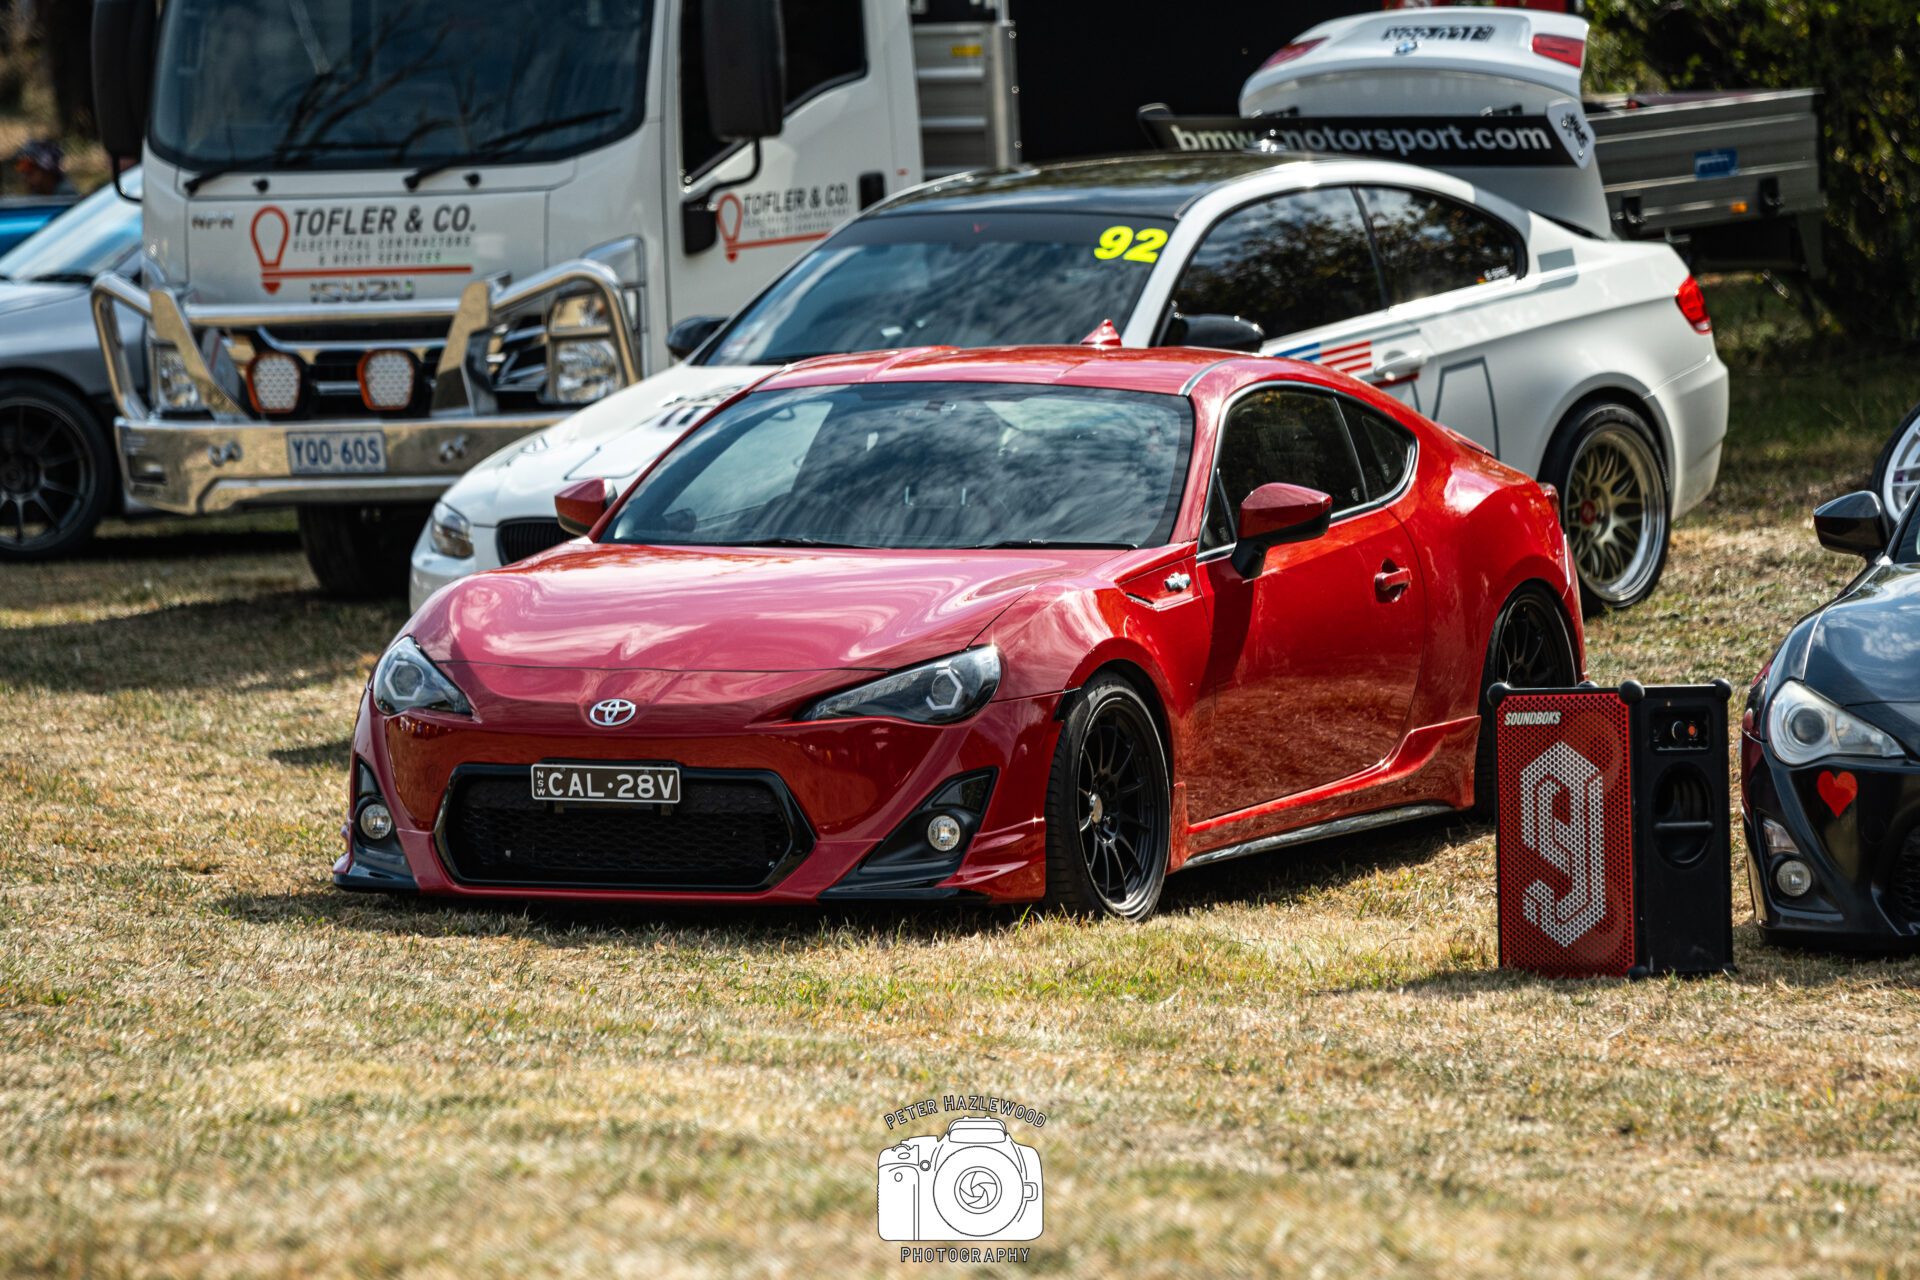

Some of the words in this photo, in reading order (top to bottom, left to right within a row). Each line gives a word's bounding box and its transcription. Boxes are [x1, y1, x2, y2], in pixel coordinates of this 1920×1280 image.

[743, 189, 806, 215] TOFLER
[809, 187, 821, 208] &
[825, 183, 851, 207] CO.
[293, 206, 397, 236] TOFLER
[404, 205, 424, 234] &
[433, 203, 477, 233] CO.
[293, 238, 370, 252] ELECTRICAL
[378, 236, 471, 249] CONTRACTORS
[1093, 225, 1169, 264] 92
[309, 280, 416, 303] ISUZU
[1504, 711, 1562, 726] SOUNDBOKS
